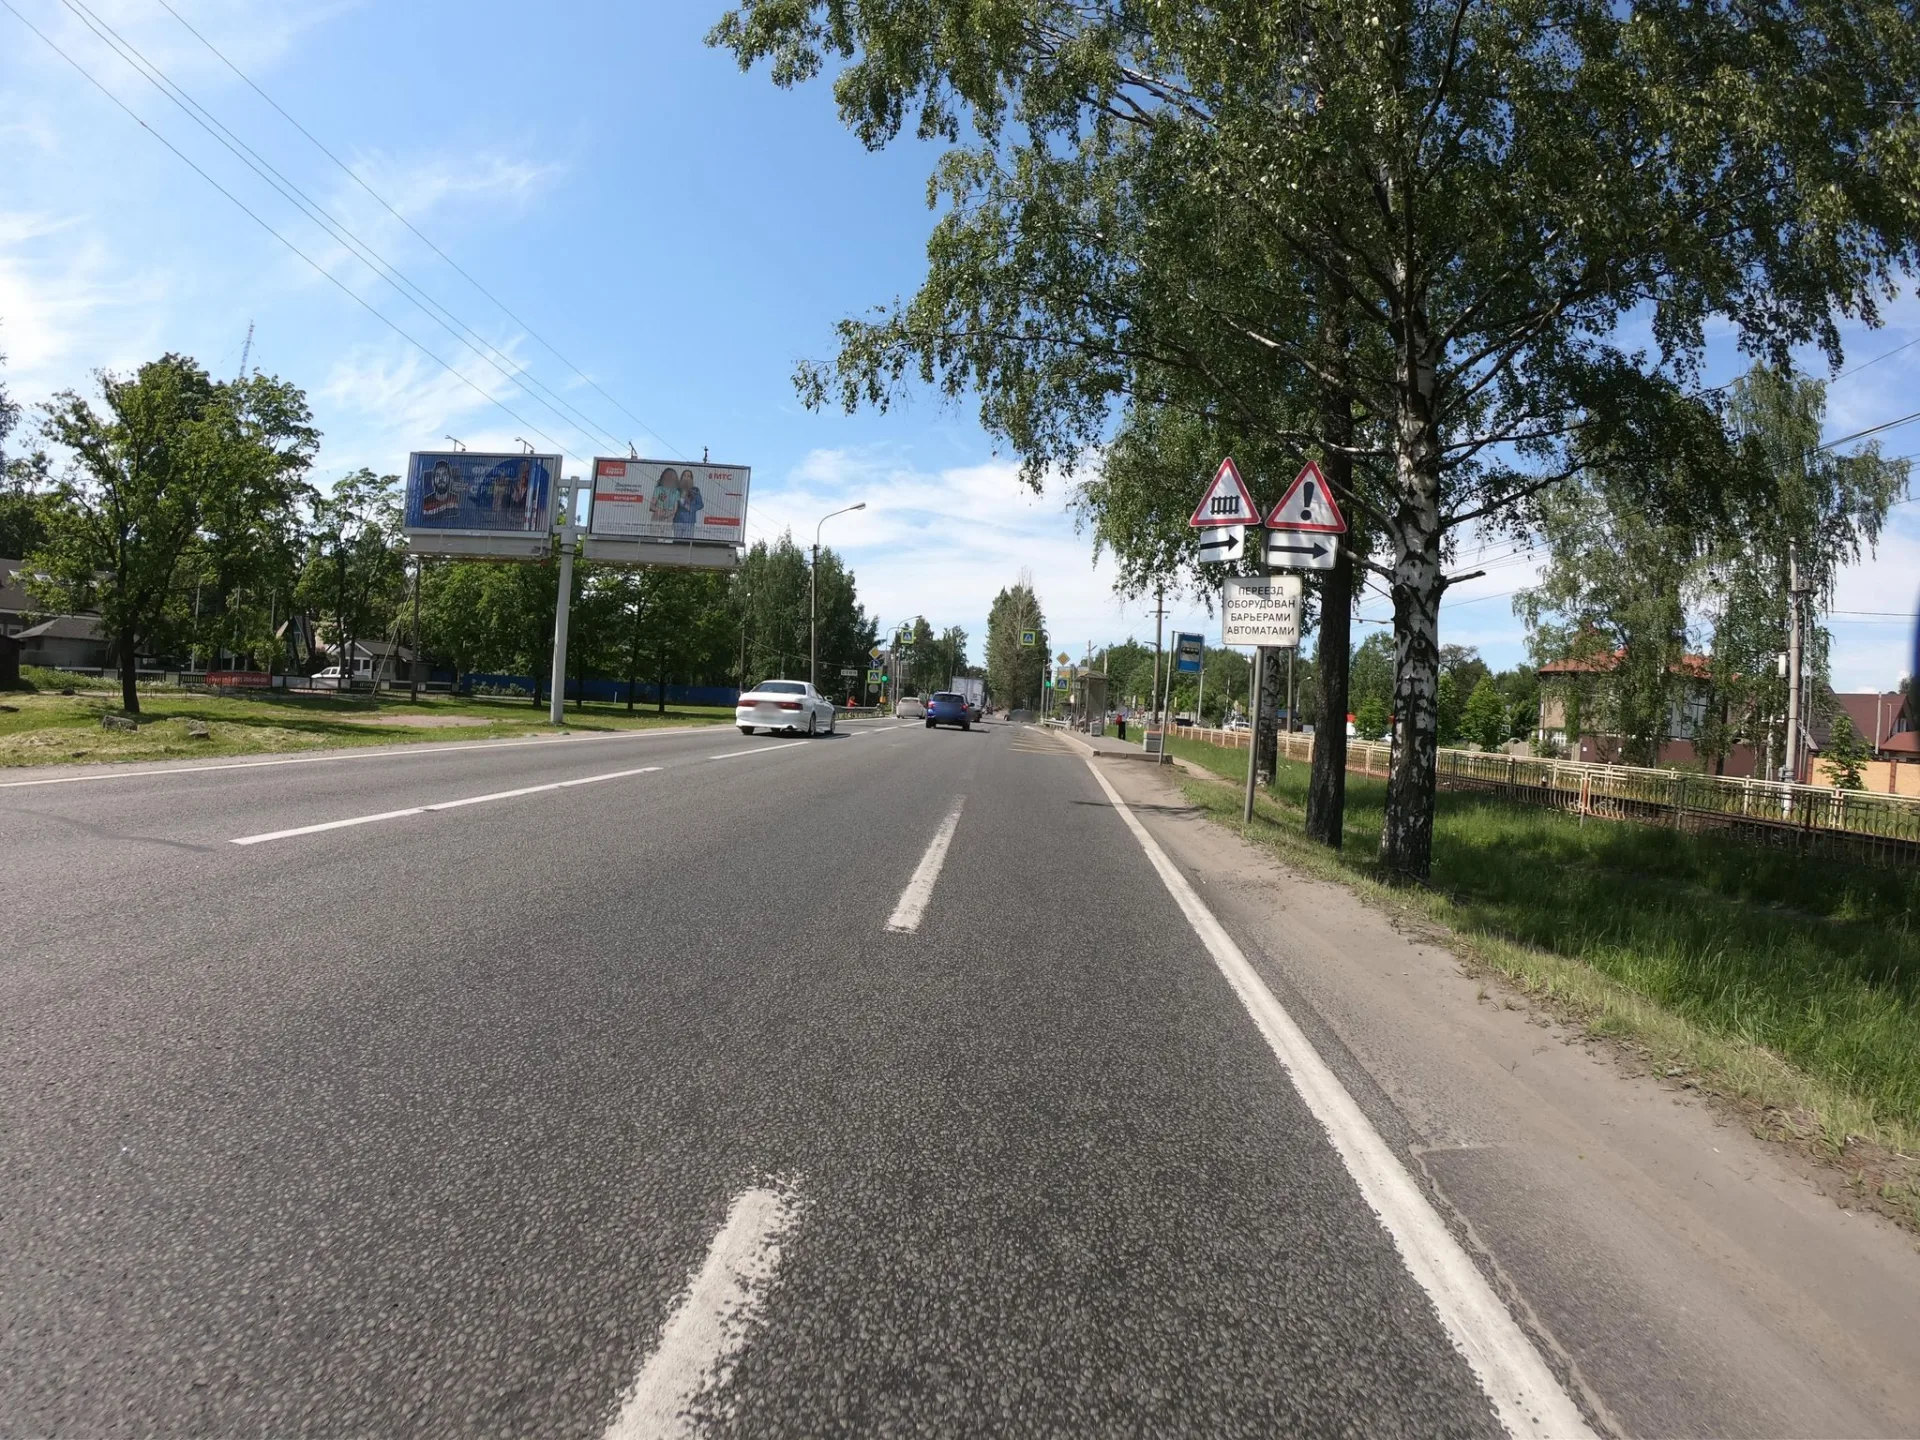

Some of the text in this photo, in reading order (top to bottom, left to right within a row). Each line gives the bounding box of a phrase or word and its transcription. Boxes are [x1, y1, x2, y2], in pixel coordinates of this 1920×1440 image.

[1238, 586, 1284, 596] ПЕРЕЕЗД
[1227, 599, 1296, 609] ОБОРУДОВАН
[1230, 613, 1291, 622] БАРЬЕРАМИ
[1227, 626, 1295, 635] АВТОМАТАМИ
